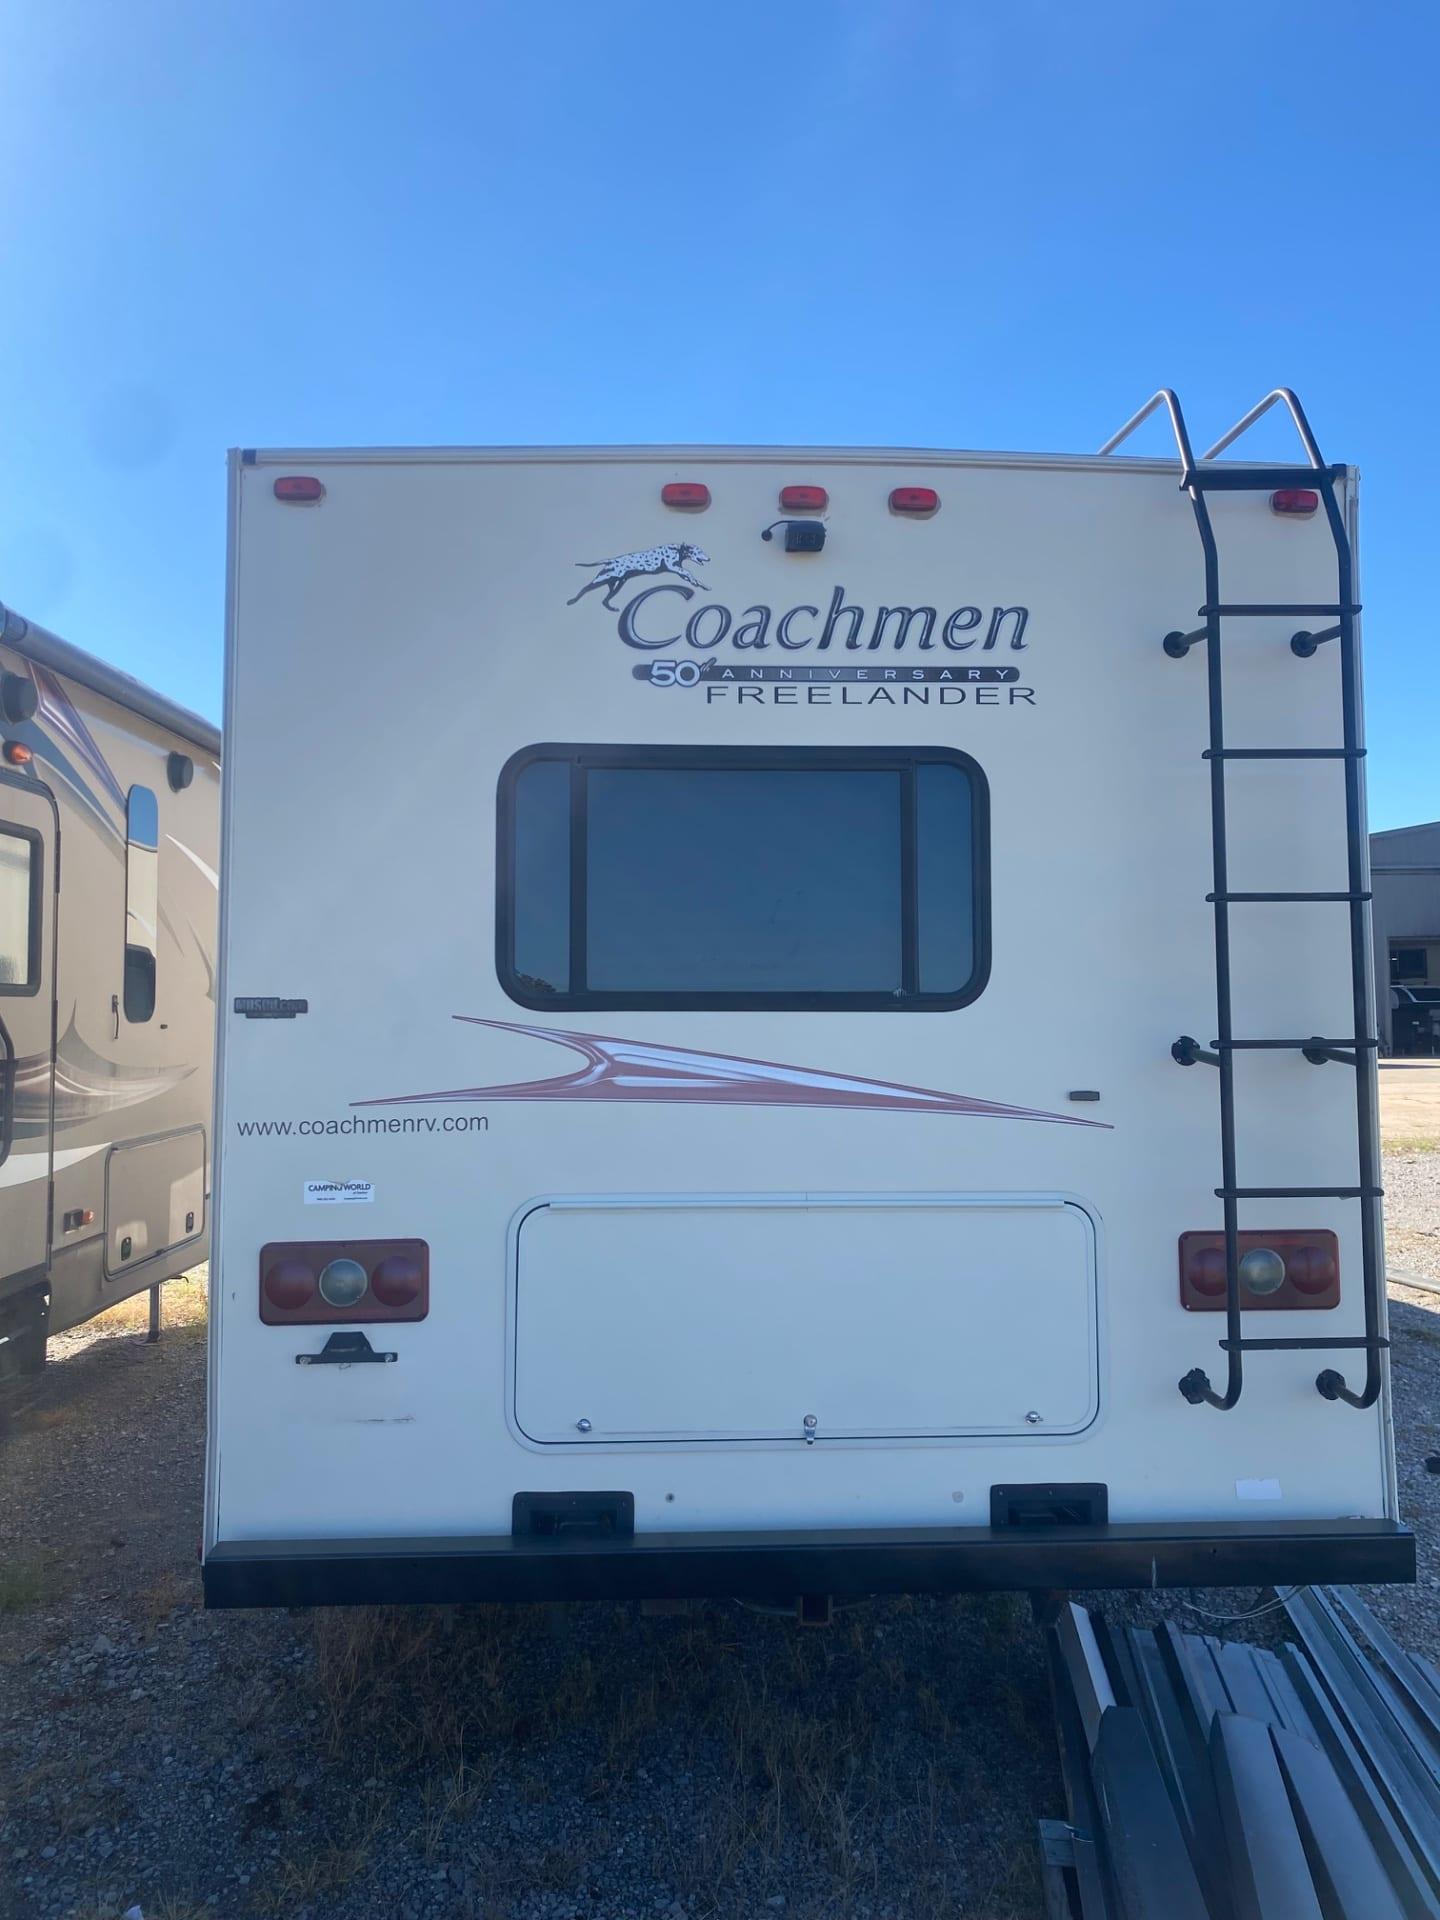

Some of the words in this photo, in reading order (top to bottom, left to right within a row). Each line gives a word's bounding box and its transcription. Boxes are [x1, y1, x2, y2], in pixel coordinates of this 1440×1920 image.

[617, 584, 1030, 651] Coachmen
[721, 667, 1010, 680] ANNIVERSARY
[706, 685, 1037, 706] FREELANDER
[237, 1115, 489, 1136] www.coachmenrv.com
[343, 1183, 371, 1191] WORLD
